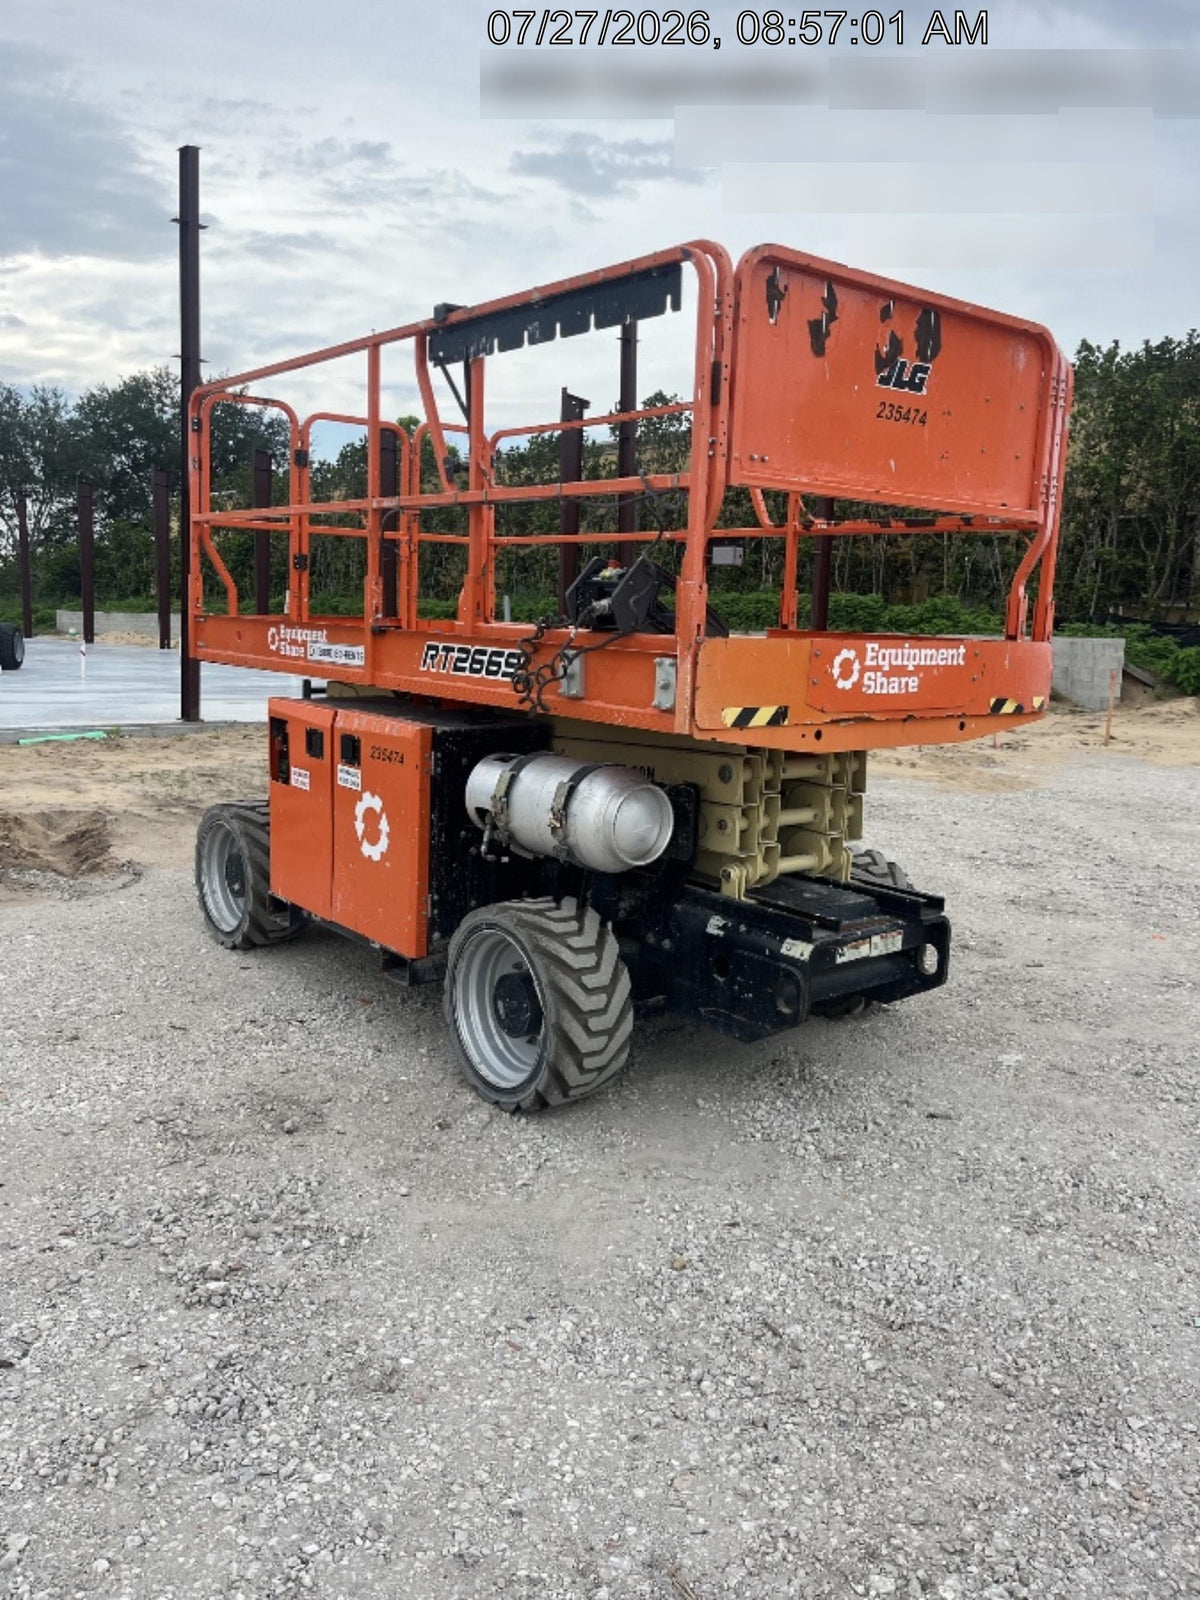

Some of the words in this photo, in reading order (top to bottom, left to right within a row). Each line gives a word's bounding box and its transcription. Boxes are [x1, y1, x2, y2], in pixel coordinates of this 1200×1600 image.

[875, 357, 932, 395] JLG
[876, 401, 927, 427] 235474
[280, 624, 328, 643] Equipment
[280, 641, 305, 657] Share
[864, 643, 966, 671] Equipment
[862, 671, 919, 694] Share
[370, 746, 404, 765] 235474
